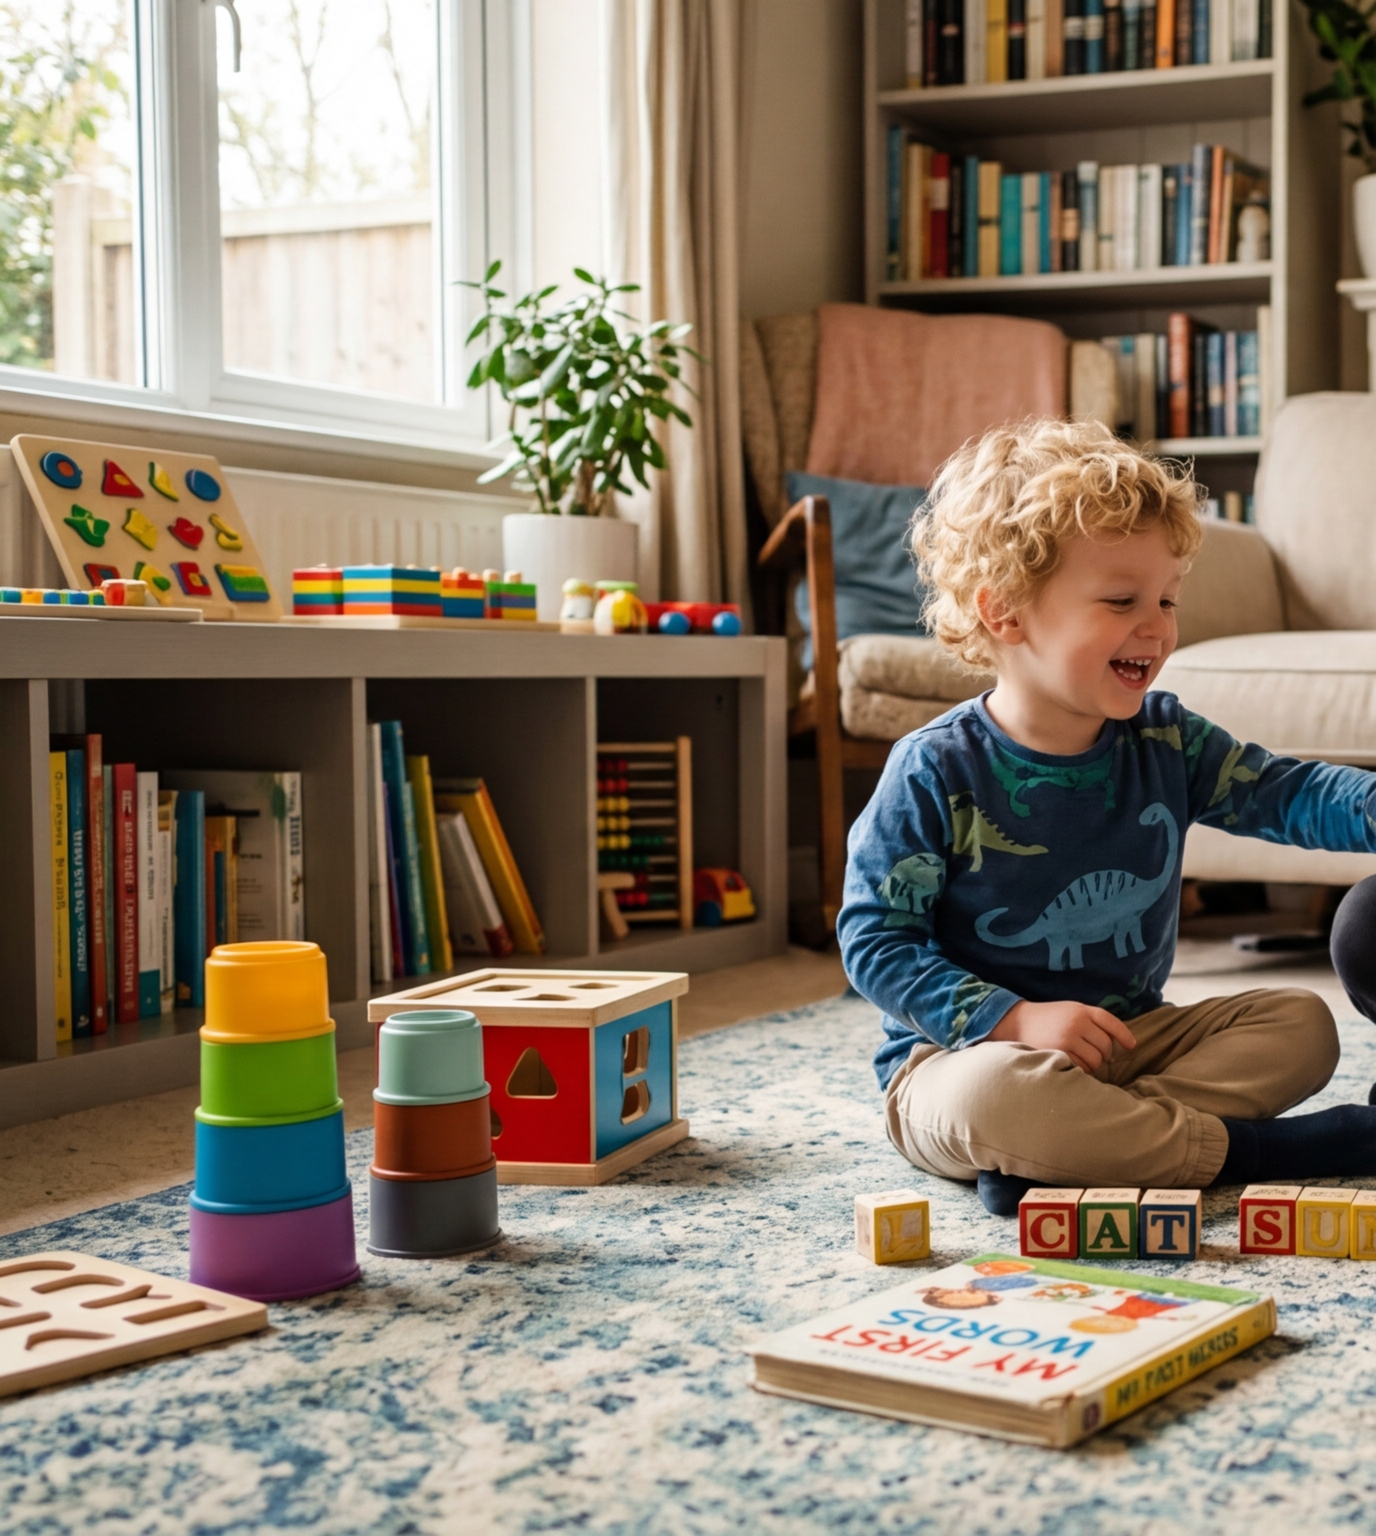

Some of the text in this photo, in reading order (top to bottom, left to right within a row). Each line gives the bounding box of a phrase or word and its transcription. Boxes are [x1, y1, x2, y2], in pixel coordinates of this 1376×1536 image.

[1030, 1212, 1185, 1250] CAT
[811, 1325, 973, 1362] FIRST
[877, 1309, 1095, 1358] WORDS
[972, 1353, 1078, 1380] MY
